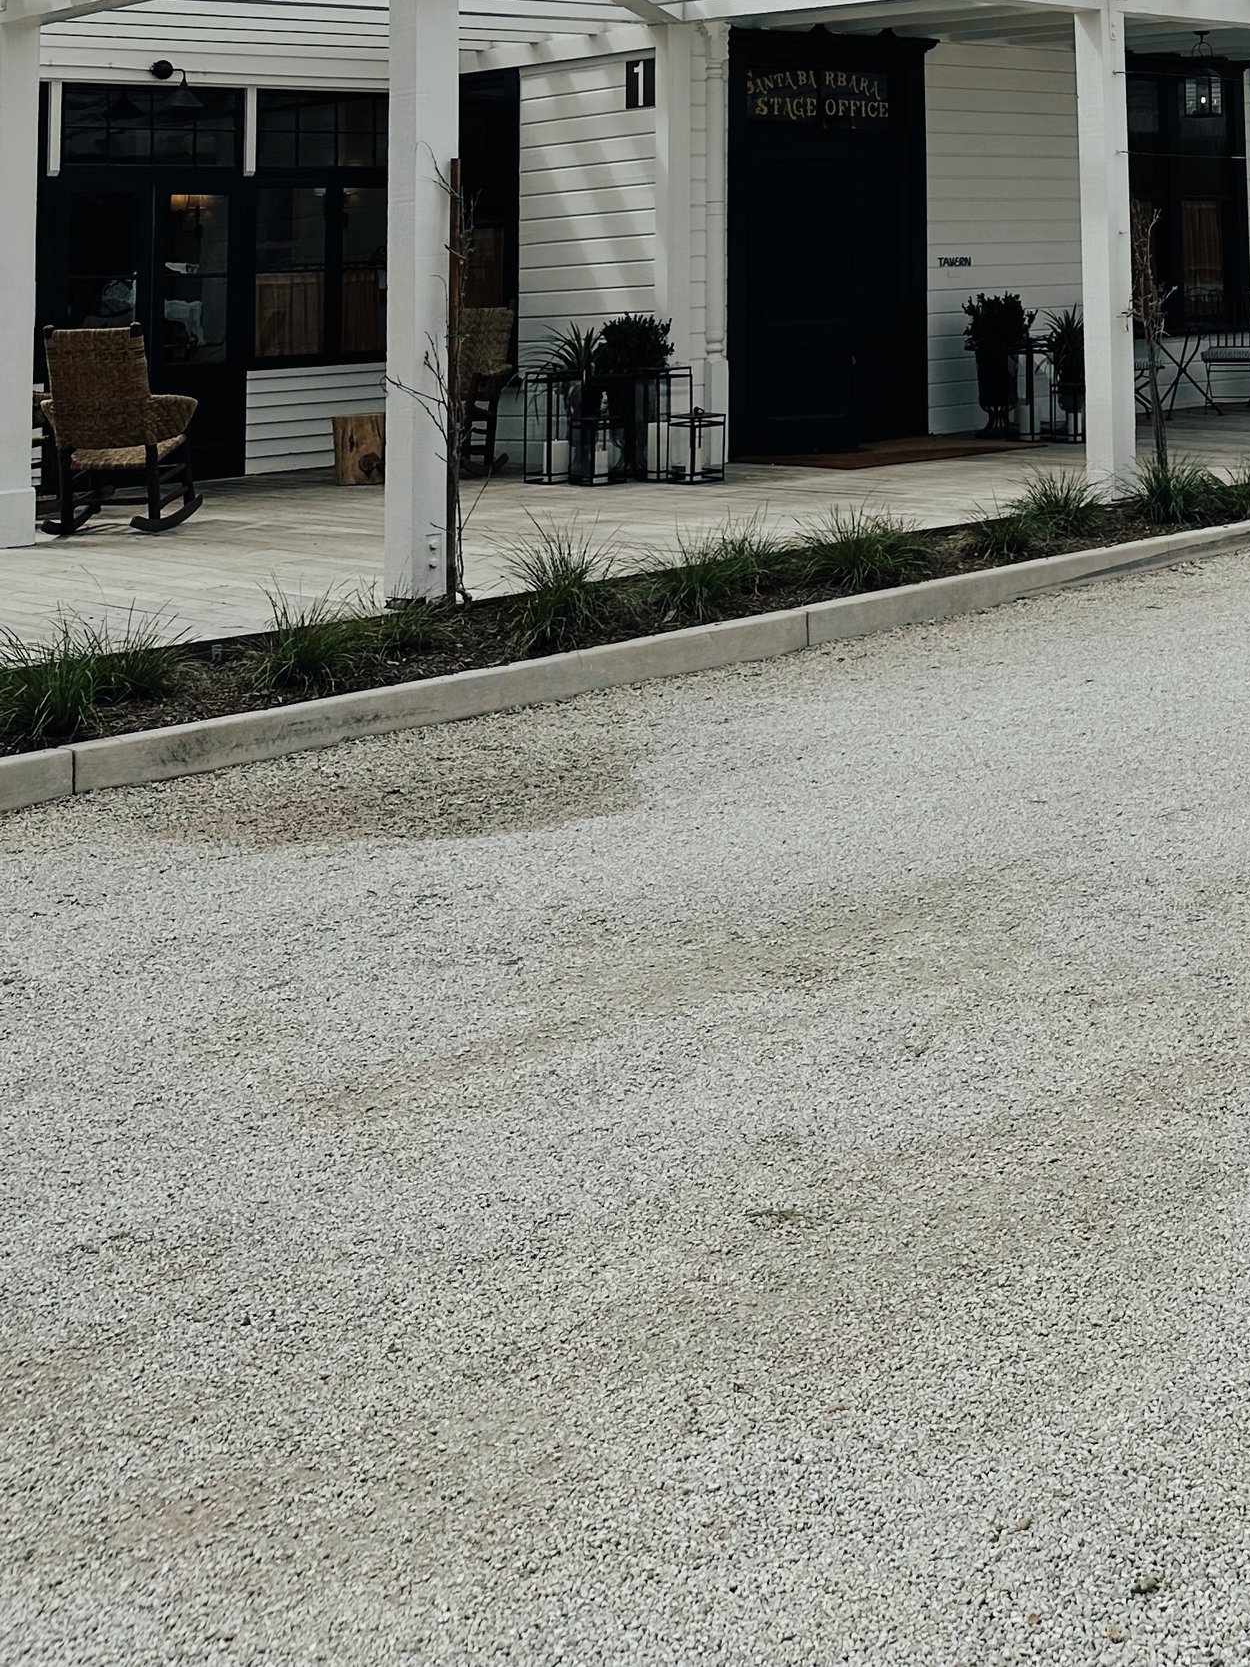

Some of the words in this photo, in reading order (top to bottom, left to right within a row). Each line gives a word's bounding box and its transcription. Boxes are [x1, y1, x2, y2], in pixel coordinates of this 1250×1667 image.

[633, 60, 644, 106] 1
[755, 97, 817, 120] STAGE
[825, 99, 888, 118] OFFICE
[937, 256, 972, 267] TAVERN
